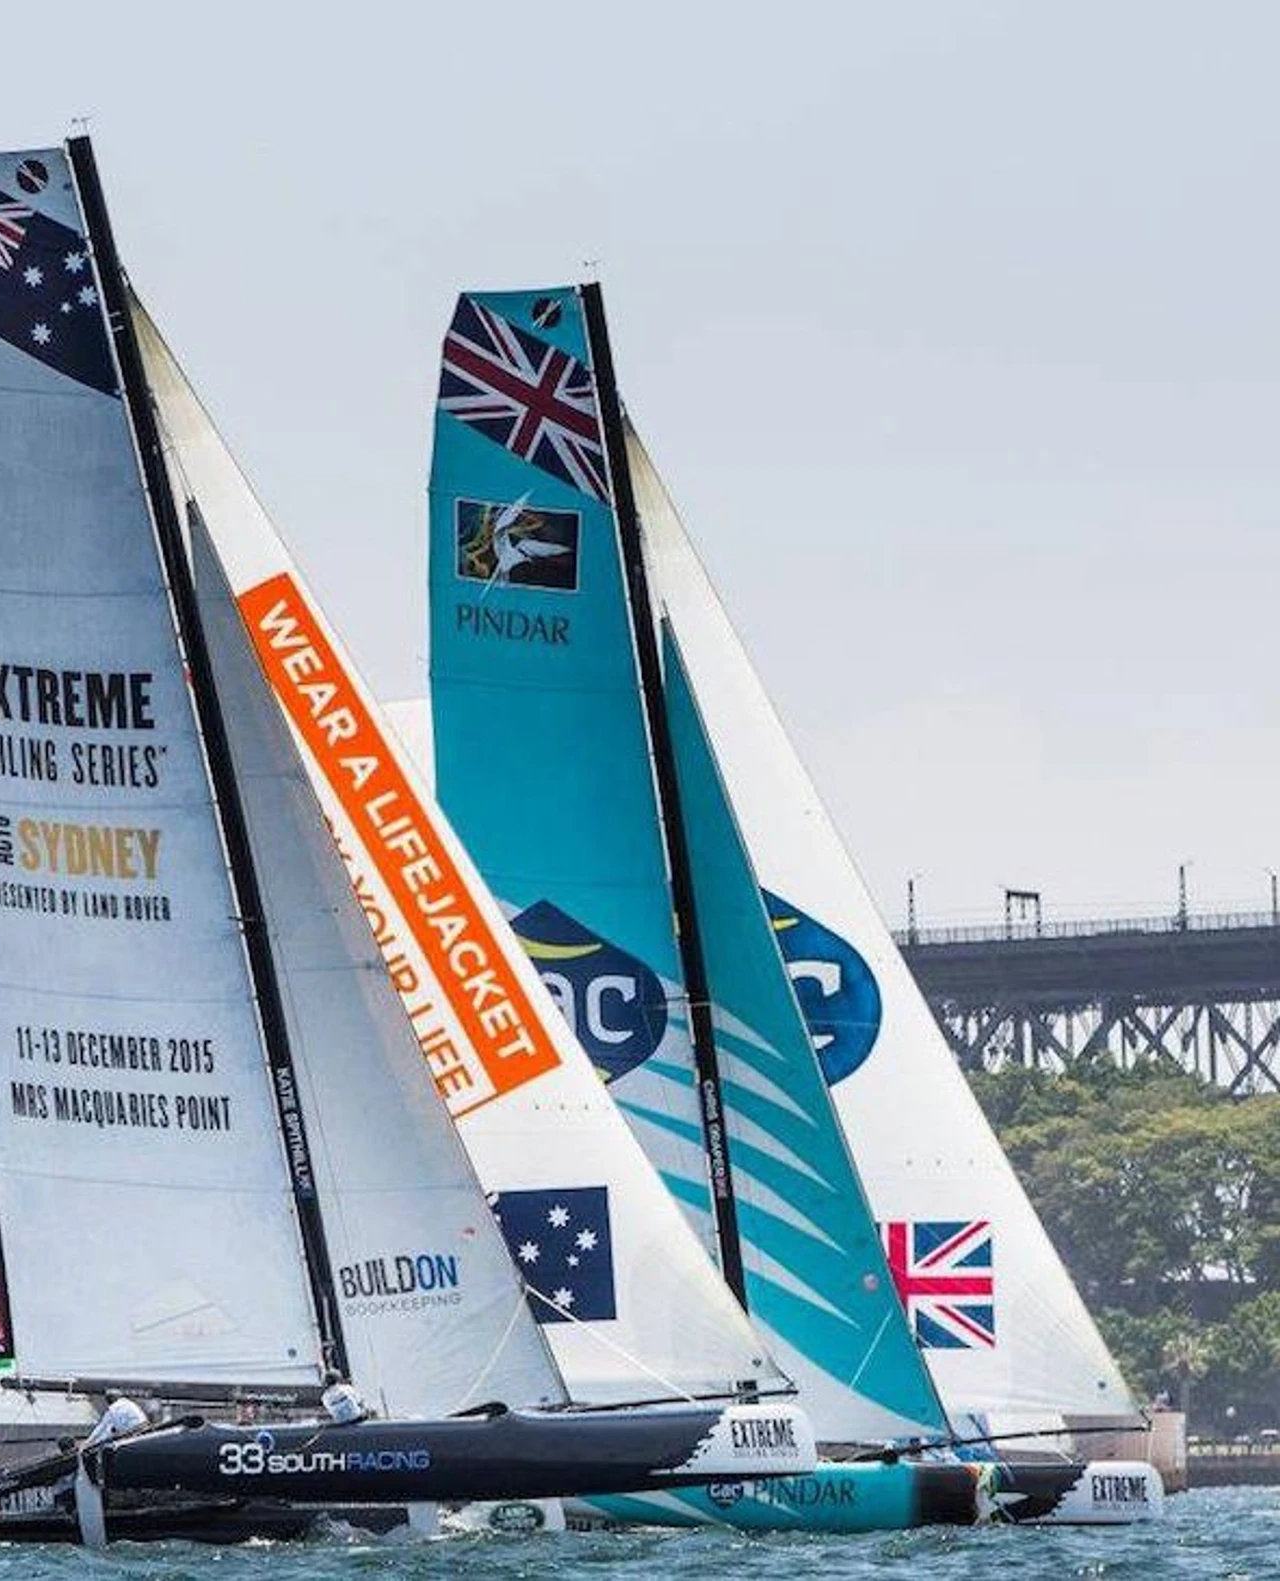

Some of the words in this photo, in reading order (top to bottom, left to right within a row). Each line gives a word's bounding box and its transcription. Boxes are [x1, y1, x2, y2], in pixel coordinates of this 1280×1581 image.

[456, 604, 570, 645] PINDAR
[17, 817, 162, 880] SYDNEY
[259, 600, 359, 747] WEAR
[338, 755, 380, 791] A
[365, 790, 537, 1060] LIFEJACKET
[61, 890, 79, 916] BY
[84, 893, 120, 920] LAND
[124, 895, 172, 922] ROVER
[540, 971, 638, 1044] ac
[16, 1026, 62, 1063] 11-13
[67, 1031, 163, 1071] DECEMBER
[167, 1038, 215, 1073] 2015
[10, 1081, 48, 1119] MRS
[53, 1085, 170, 1129] MACQUARIES
[175, 1095, 231, 1131] POINT
[345, 1293, 461, 1317] BOOKKEEPING
[730, 1418, 797, 1449] EXTREME
[753, 1477, 856, 1506] PINDAR
[1091, 1474, 1149, 1502] EXTREME
